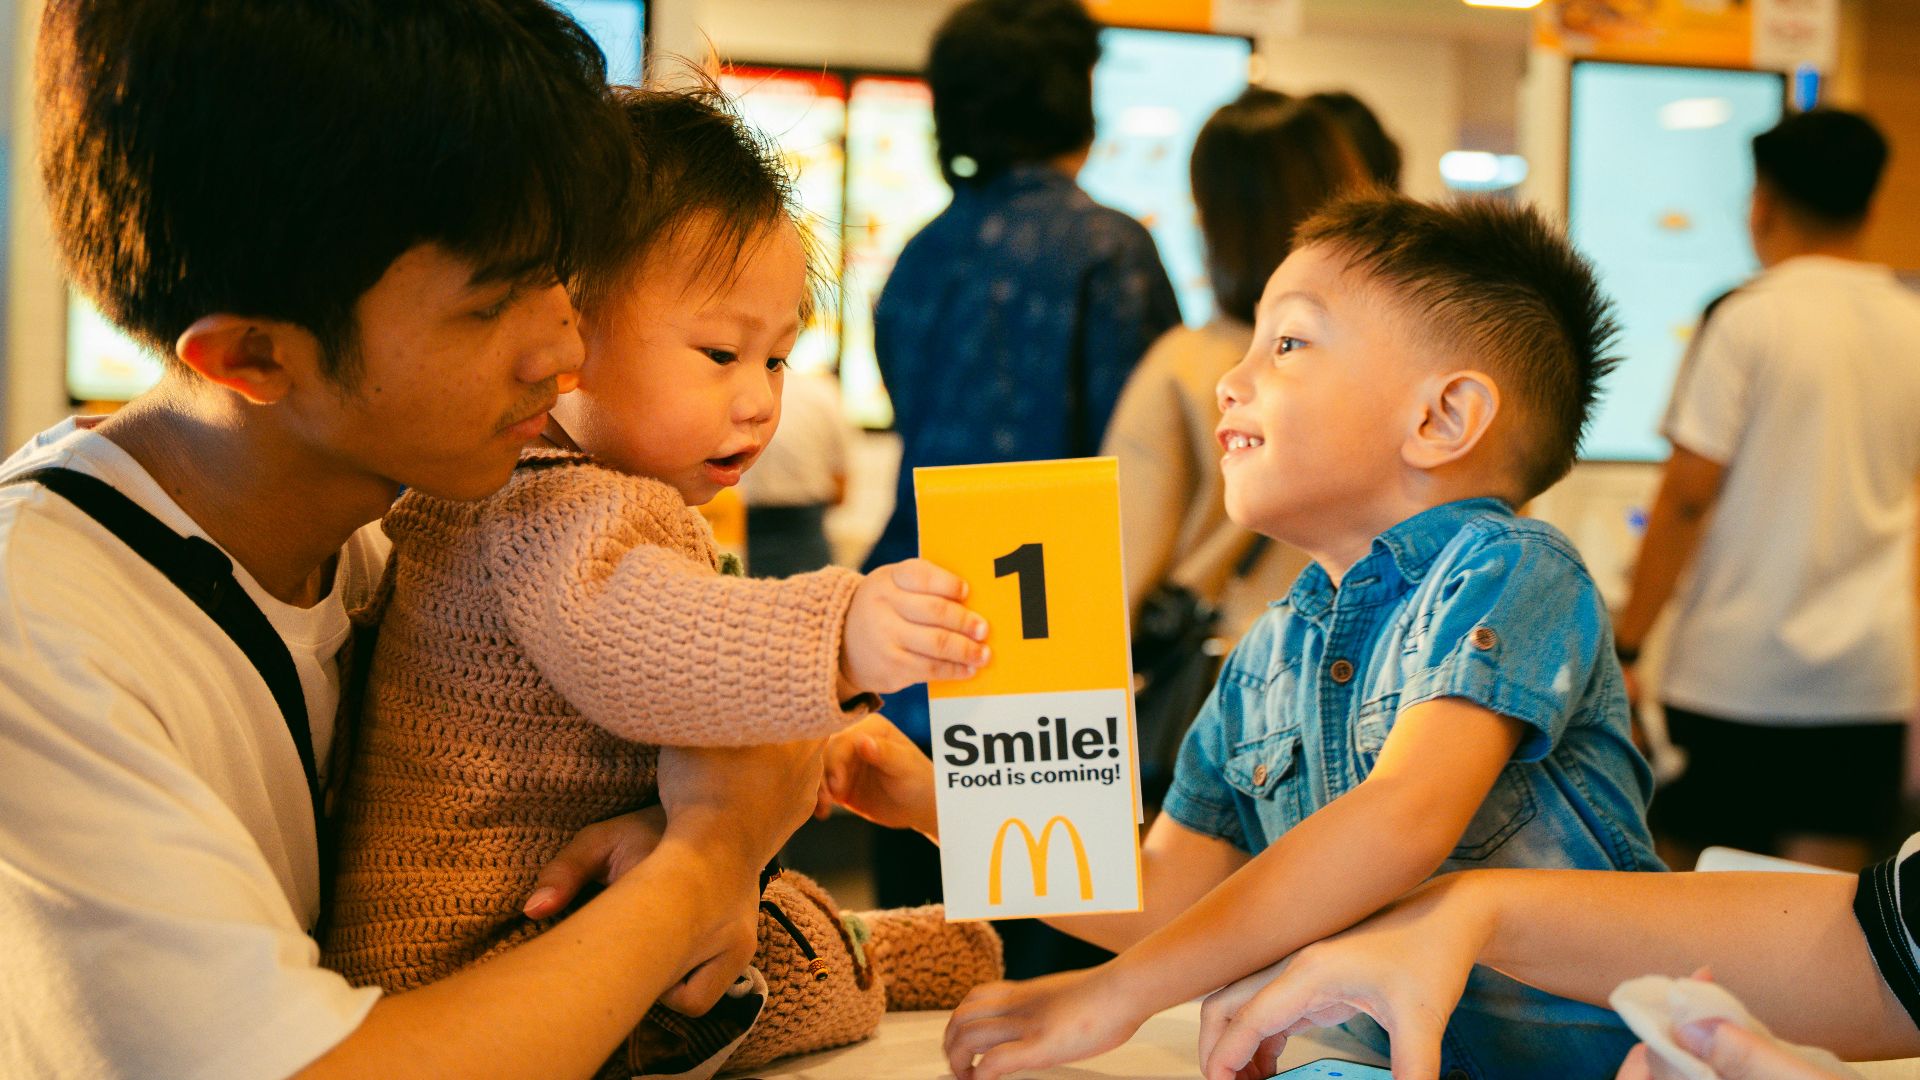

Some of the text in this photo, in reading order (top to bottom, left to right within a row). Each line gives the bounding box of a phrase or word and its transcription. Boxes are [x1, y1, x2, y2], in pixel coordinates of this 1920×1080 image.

[994, 542, 1049, 640] 1
[943, 716, 1120, 767] Smile!
[948, 764, 1120, 788] Food is coming!
